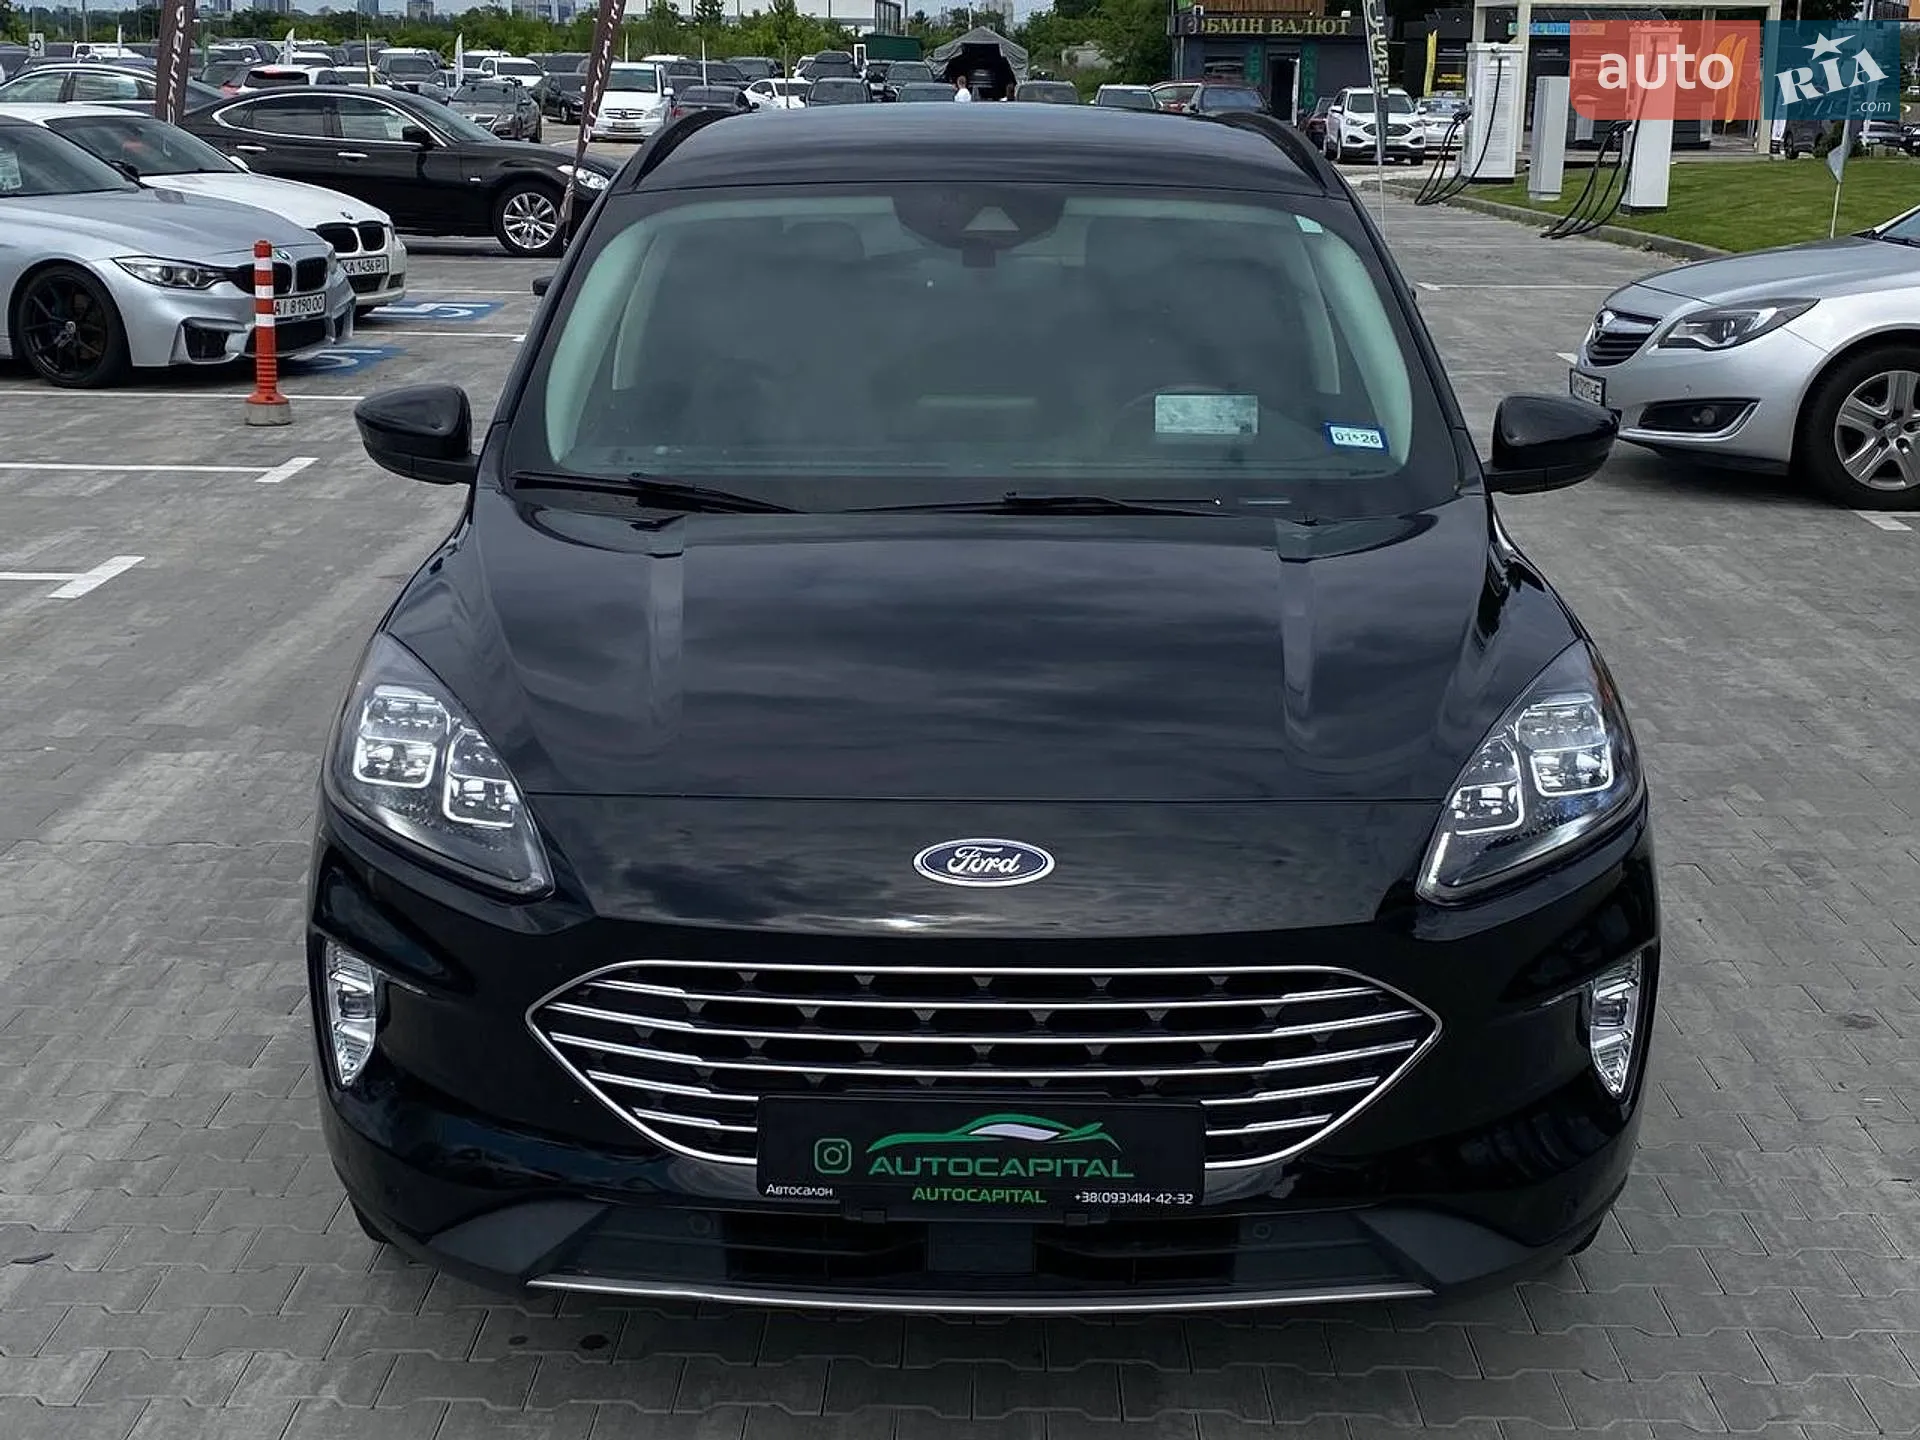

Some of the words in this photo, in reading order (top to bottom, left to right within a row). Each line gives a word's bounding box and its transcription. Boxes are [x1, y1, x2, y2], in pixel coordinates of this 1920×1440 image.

[1271, 19, 1351, 35] ВАЛЮТ
[947, 846, 1021, 873] Ford
[868, 1155, 1135, 1178] AUTOCAPITAL
[765, 1184, 834, 1197] Автосалон
[912, 1187, 1047, 1204] AUTOCAPITAL
[1074, 1191, 1194, 1205] +38(093)414-42-32
